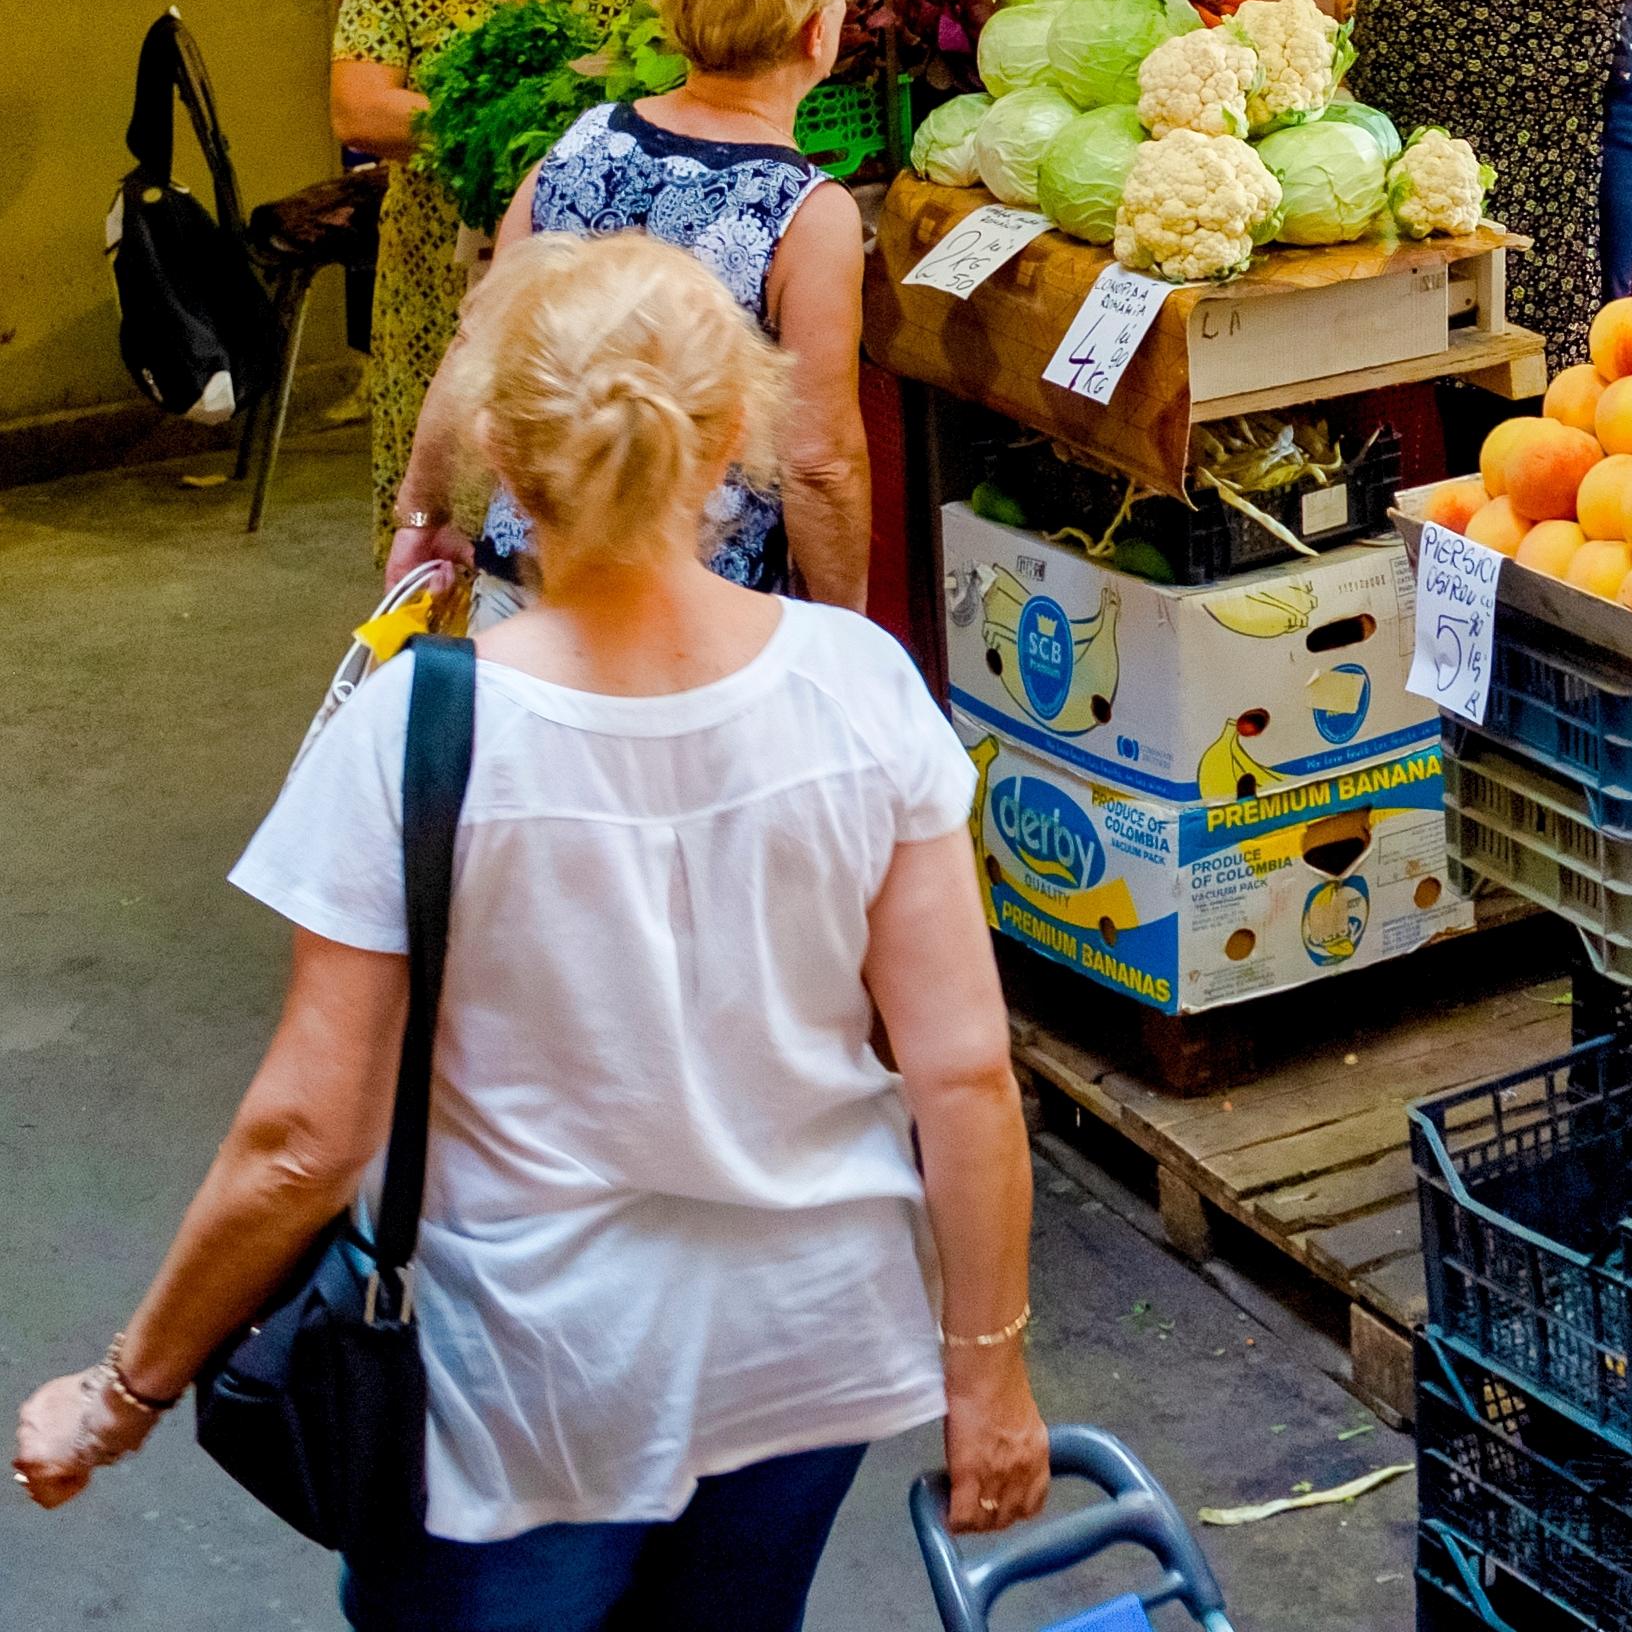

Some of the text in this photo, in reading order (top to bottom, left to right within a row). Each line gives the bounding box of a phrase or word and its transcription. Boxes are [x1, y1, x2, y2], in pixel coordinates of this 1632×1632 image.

[1068, 314, 1106, 391] 4
[1423, 526, 1498, 584] PIERSICI
[1028, 631, 1063, 665] SCB
[1433, 614, 1469, 692] 5
[1091, 789, 1168, 834] PRODUCE OF
[1206, 783, 1332, 833] PREMIUM
[1000, 775, 1095, 890] derby
[1104, 816, 1172, 854] COLOMBIA
[1111, 838, 1166, 866] VACUUM PACK
[1191, 848, 1262, 876] PRODUCE
[1191, 856, 1294, 891] OF COLOMBIA
[1024, 874, 1071, 909] QUALITY
[1191, 879, 1268, 903] VACUUM PACK
[1002, 899, 1077, 961] PREMIUM
[1081, 943, 1173, 1003] BANANAS
